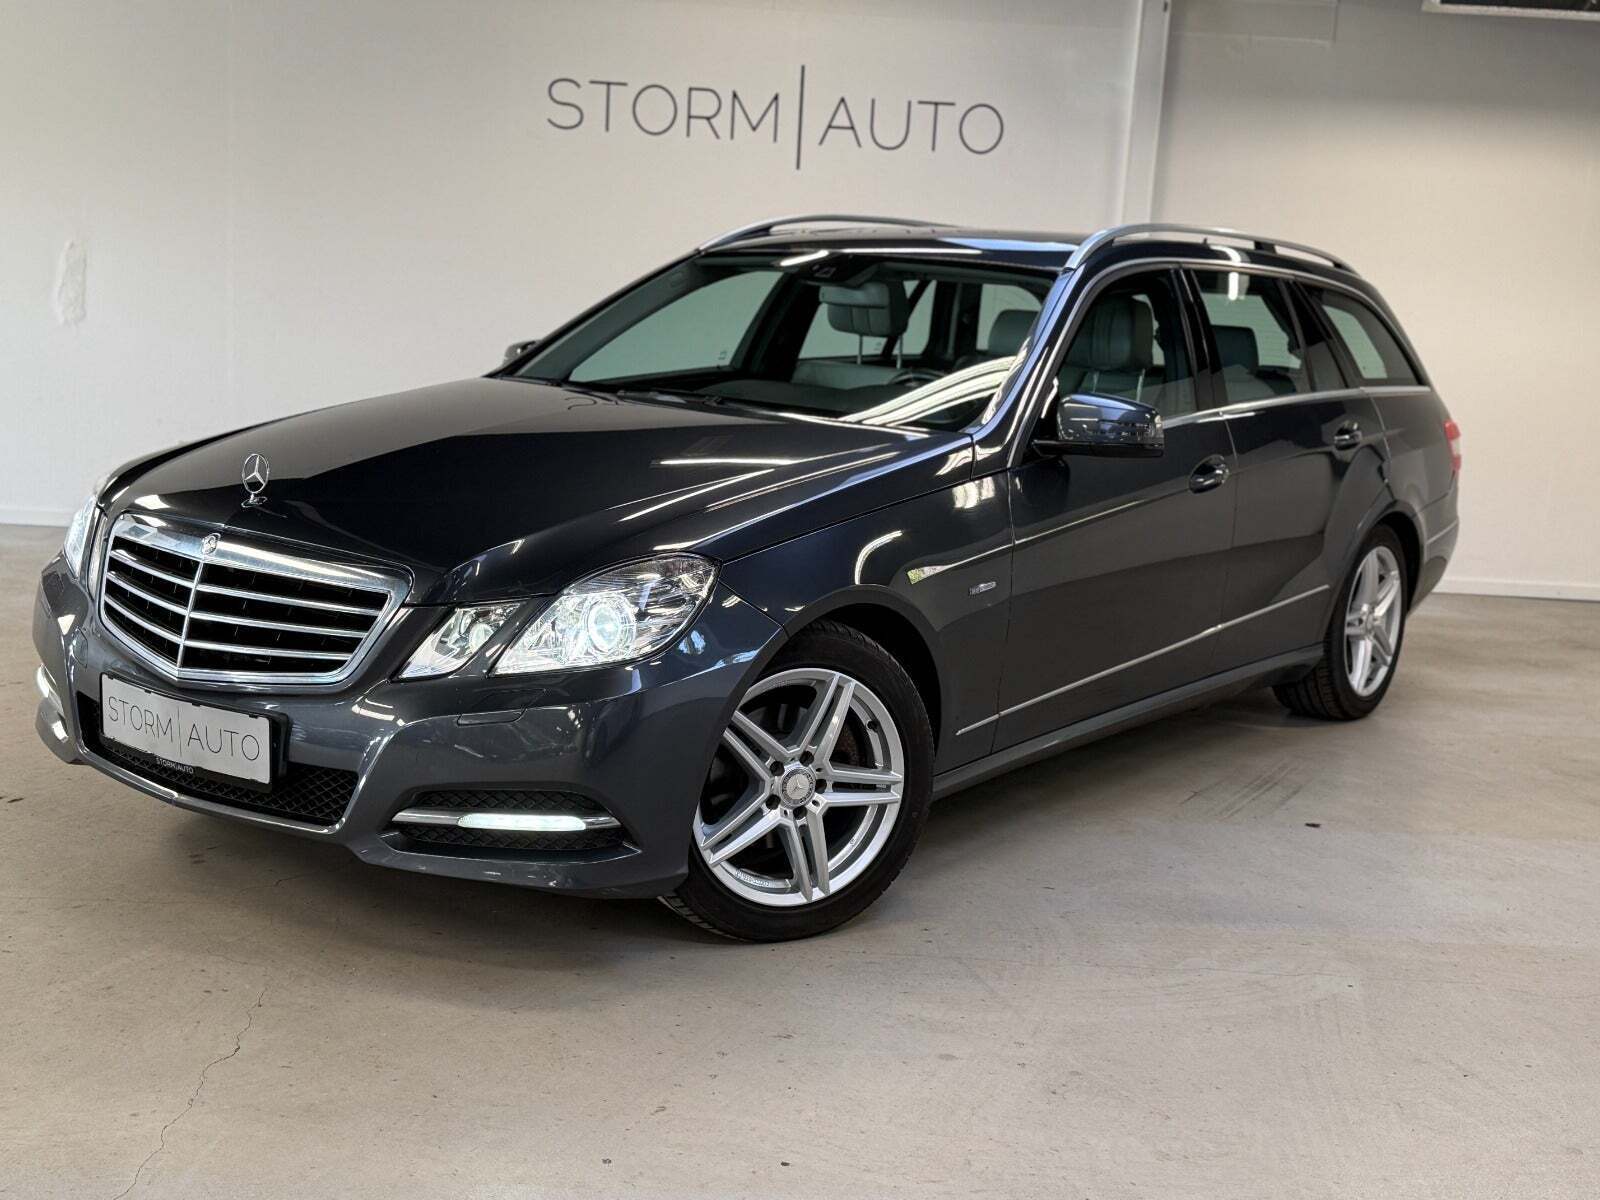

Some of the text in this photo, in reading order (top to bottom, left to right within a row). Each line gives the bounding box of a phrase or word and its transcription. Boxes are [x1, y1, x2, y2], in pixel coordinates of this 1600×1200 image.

[546, 77, 1005, 155] STORM AUTO
[107, 696, 260, 761] STORM AUTO
